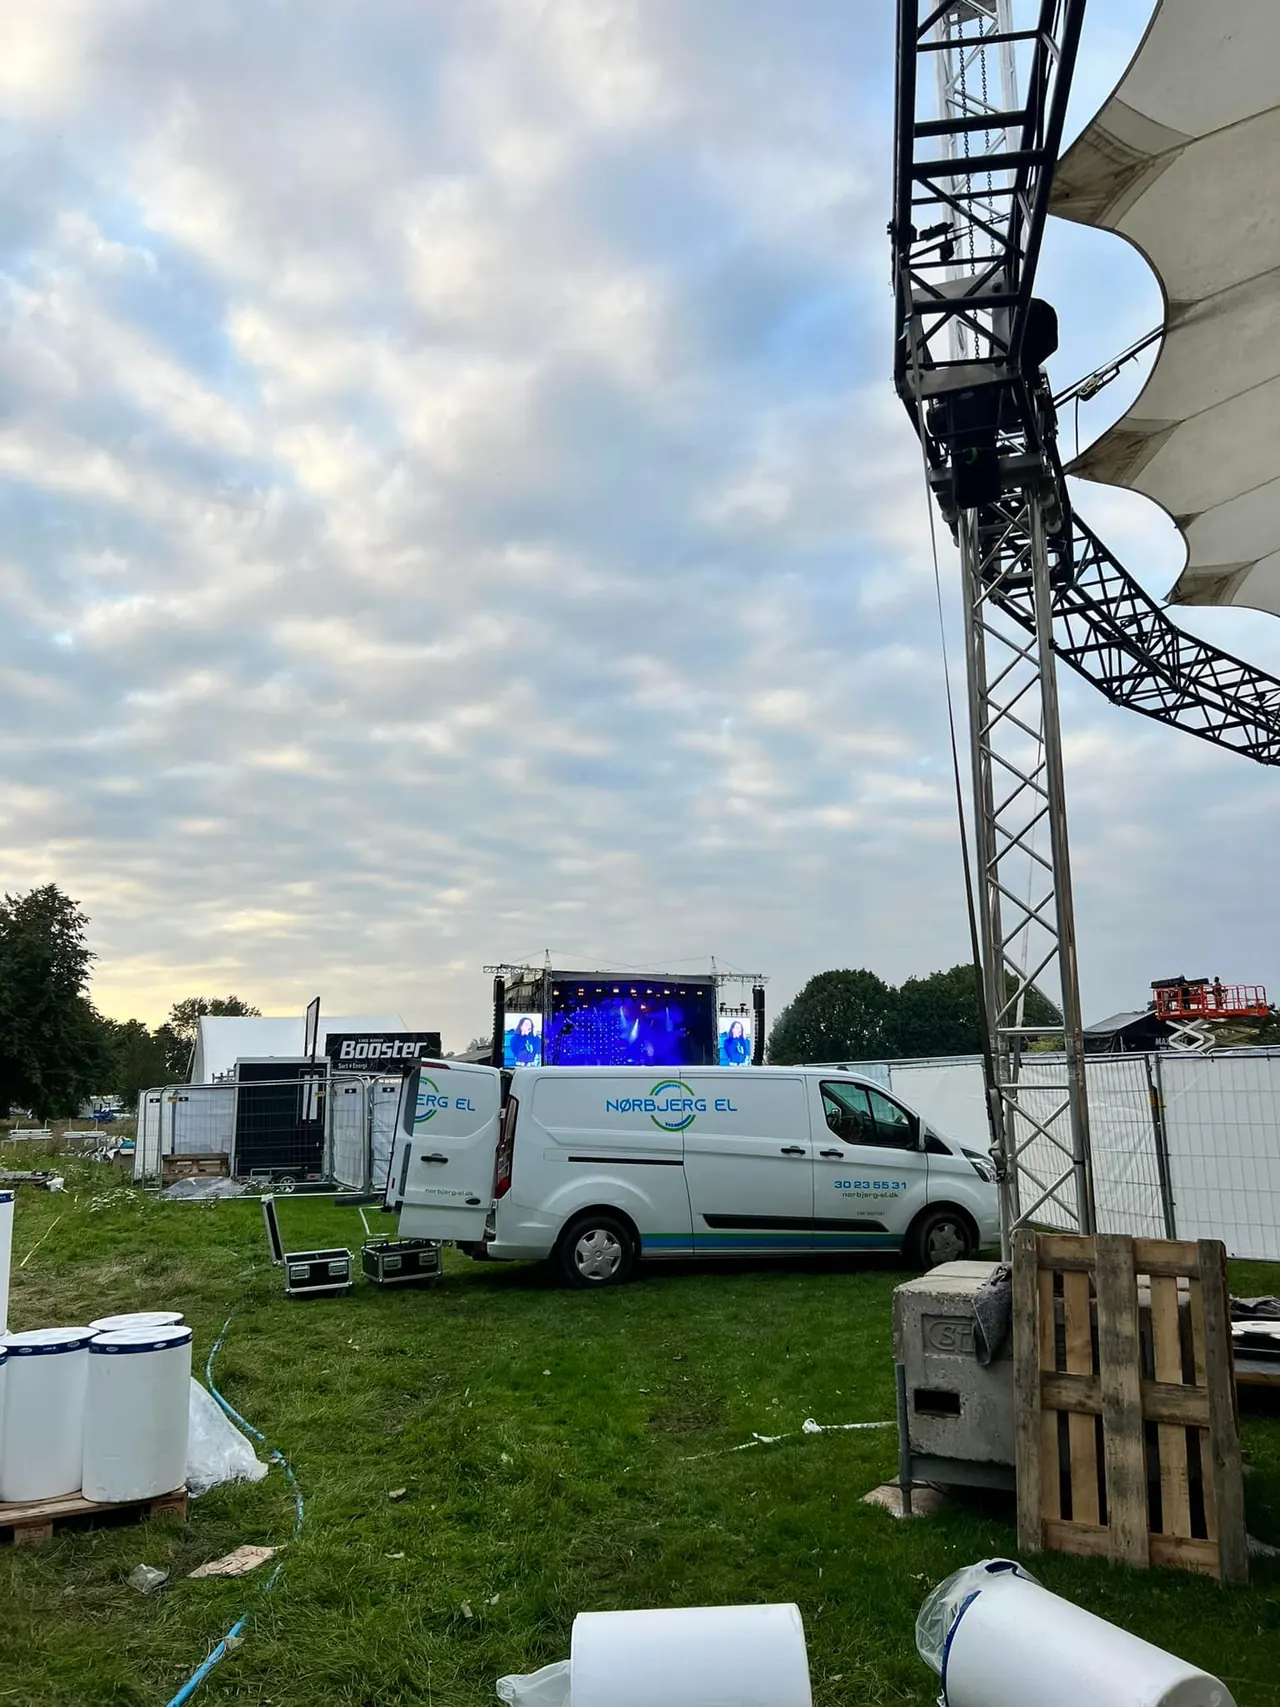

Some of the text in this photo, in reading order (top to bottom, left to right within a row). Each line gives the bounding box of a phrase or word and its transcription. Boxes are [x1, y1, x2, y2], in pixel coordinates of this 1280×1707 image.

[340, 1040, 427, 1059] Booster
[456, 1098, 476, 1112] EL
[606, 1098, 738, 1113] NØRBJERG EL
[834, 1180, 907, 1190] 30 23 55 31
[842, 1191, 899, 1199] norbjerg-el.dk
